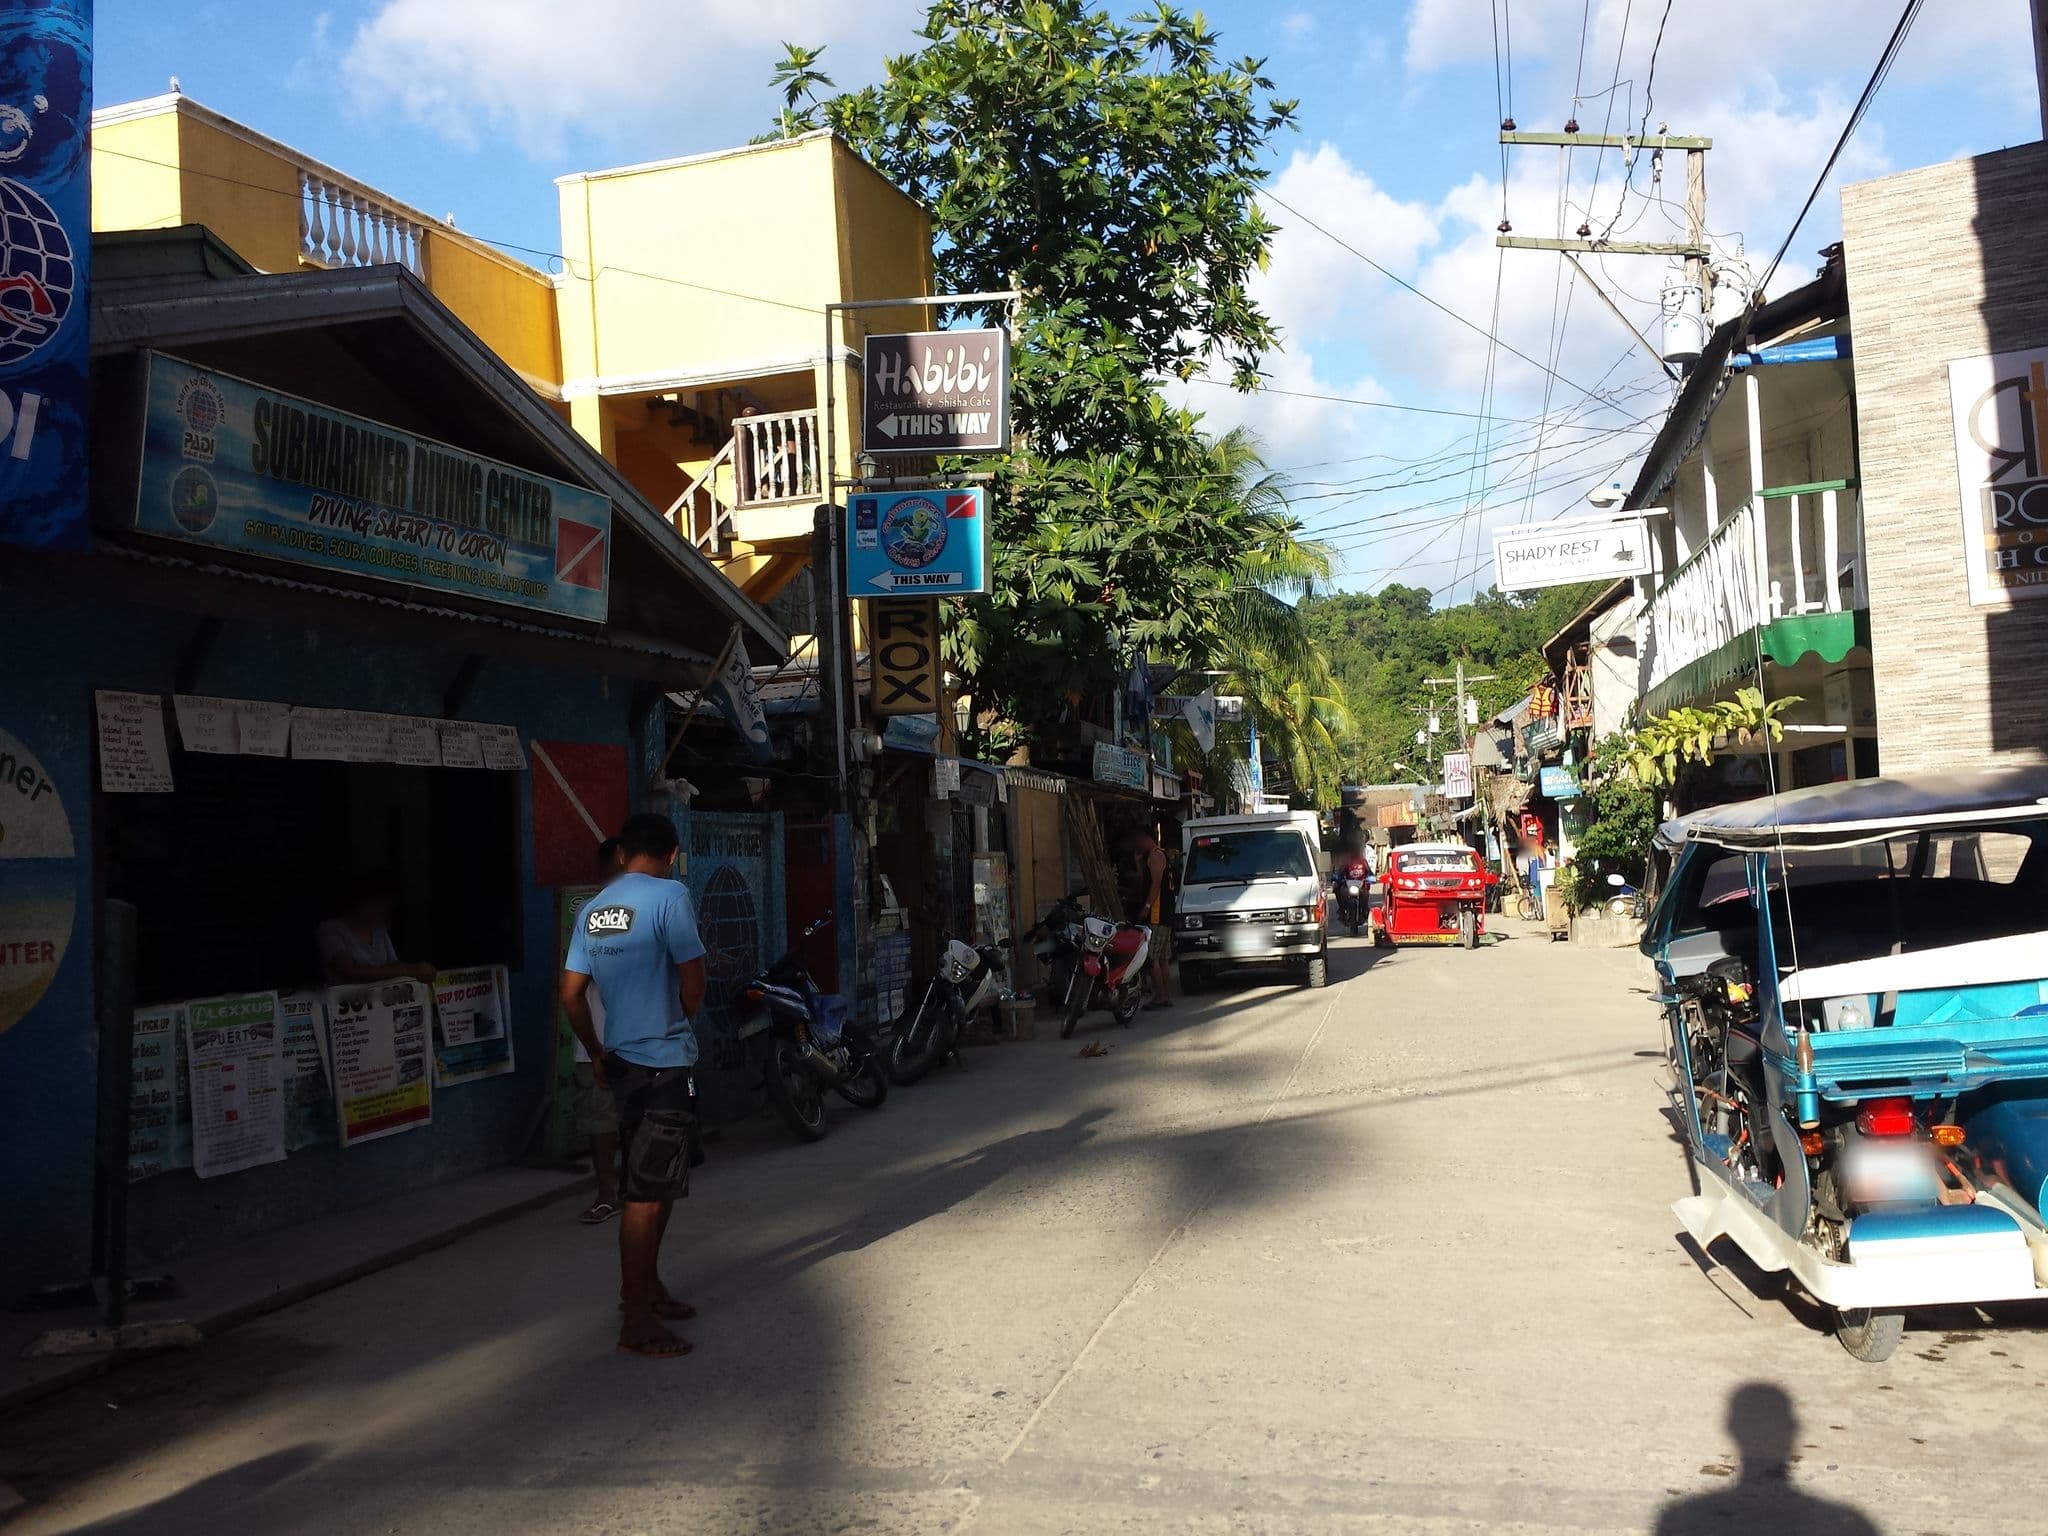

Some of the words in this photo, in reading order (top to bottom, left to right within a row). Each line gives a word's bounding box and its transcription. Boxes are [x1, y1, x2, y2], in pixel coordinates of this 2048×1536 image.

[874, 343, 992, 396] Habibi
[874, 400, 920, 409] Restaurant
[926, 399, 935, 409] &
[938, 396, 968, 409] Shisha
[970, 393, 991, 407] Cafe
[899, 414, 943, 436] THIS
[947, 412, 991, 435] WAY
[184, 431, 215, 455] PADI
[252, 397, 408, 510] SUBMARINER
[412, 443, 483, 531] DIVING
[485, 468, 552, 546] CENTER
[308, 494, 373, 539] DIVING
[374, 509, 433, 548] SAFARI
[436, 524, 456, 552] TO
[459, 531, 508, 567] CORON
[245, 520, 287, 545] SCUBA
[330, 538, 369, 561] SCUBA
[422, 557, 478, 584] FREEDIVING
[488, 573, 519, 593] ISLAND
[519, 578, 548, 598] TOURS
[1505, 545, 1556, 564] SHADY
[1559, 539, 1600, 556] REST
[893, 575, 921, 585] THIS
[923, 574, 950, 584] WAY
[878, 598, 931, 705] ROX
[209, 1028, 258, 1046] PUERTO
